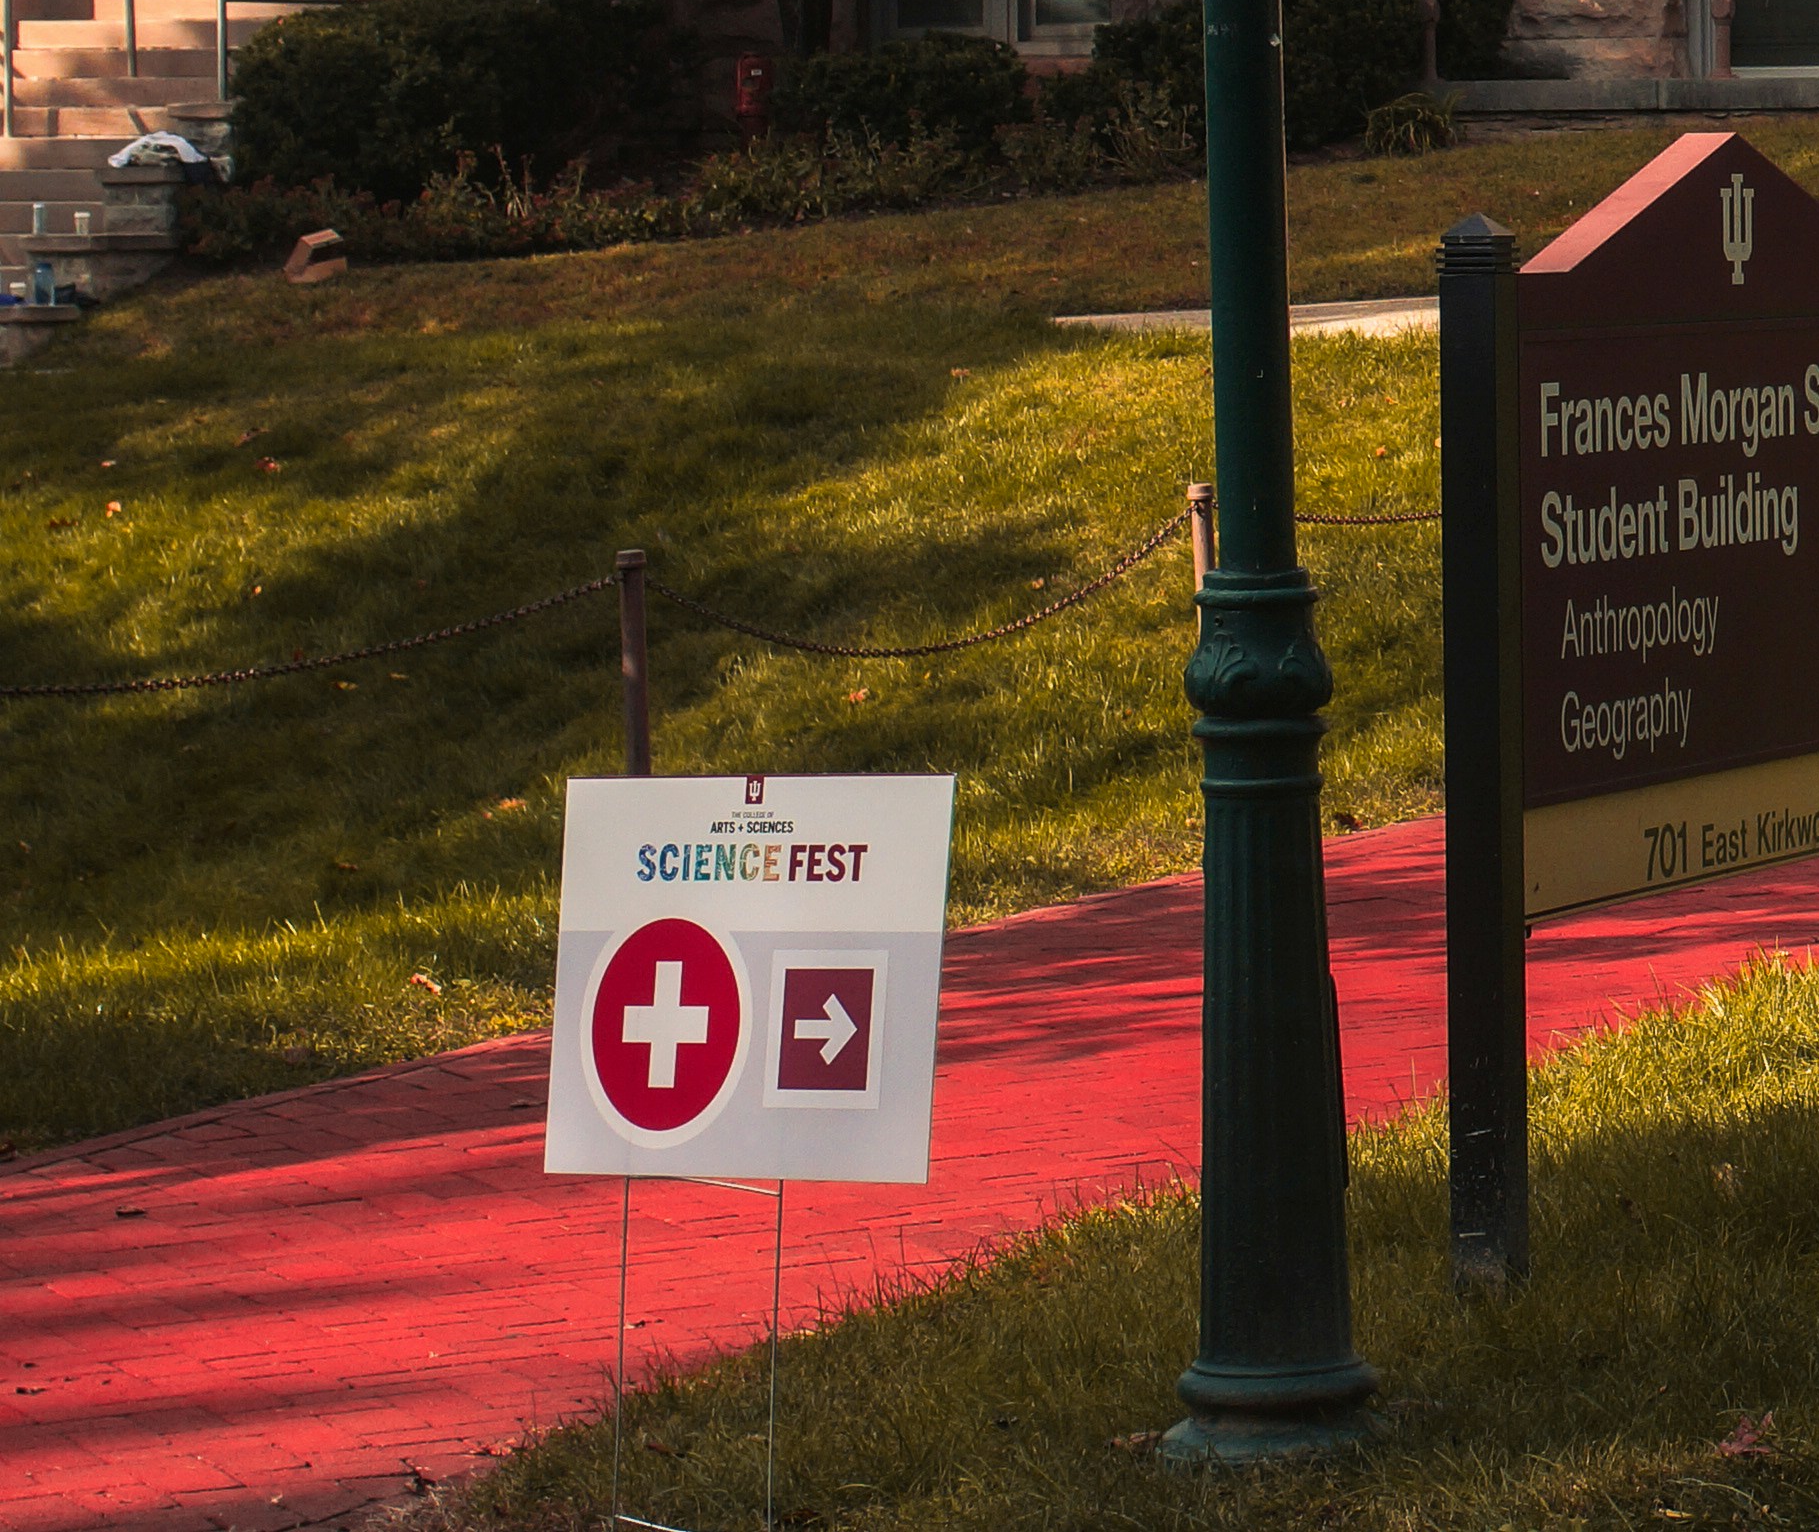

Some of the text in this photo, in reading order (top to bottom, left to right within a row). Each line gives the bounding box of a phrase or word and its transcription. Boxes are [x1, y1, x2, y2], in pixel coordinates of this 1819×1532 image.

[1540, 382, 1671, 457] Frances
[1680, 372, 1795, 457] Morgan
[1541, 472, 1798, 568] Student Building
[1561, 586, 1719, 663] Anthropology
[1561, 677, 1691, 760] Geography
[636, 843, 868, 882] SCIENCE FEST
[710, 821, 735, 833] ARTS
[746, 821, 794, 833] SCIENCES
[1644, 821, 1688, 881] 701
[1702, 819, 1748, 868] East
